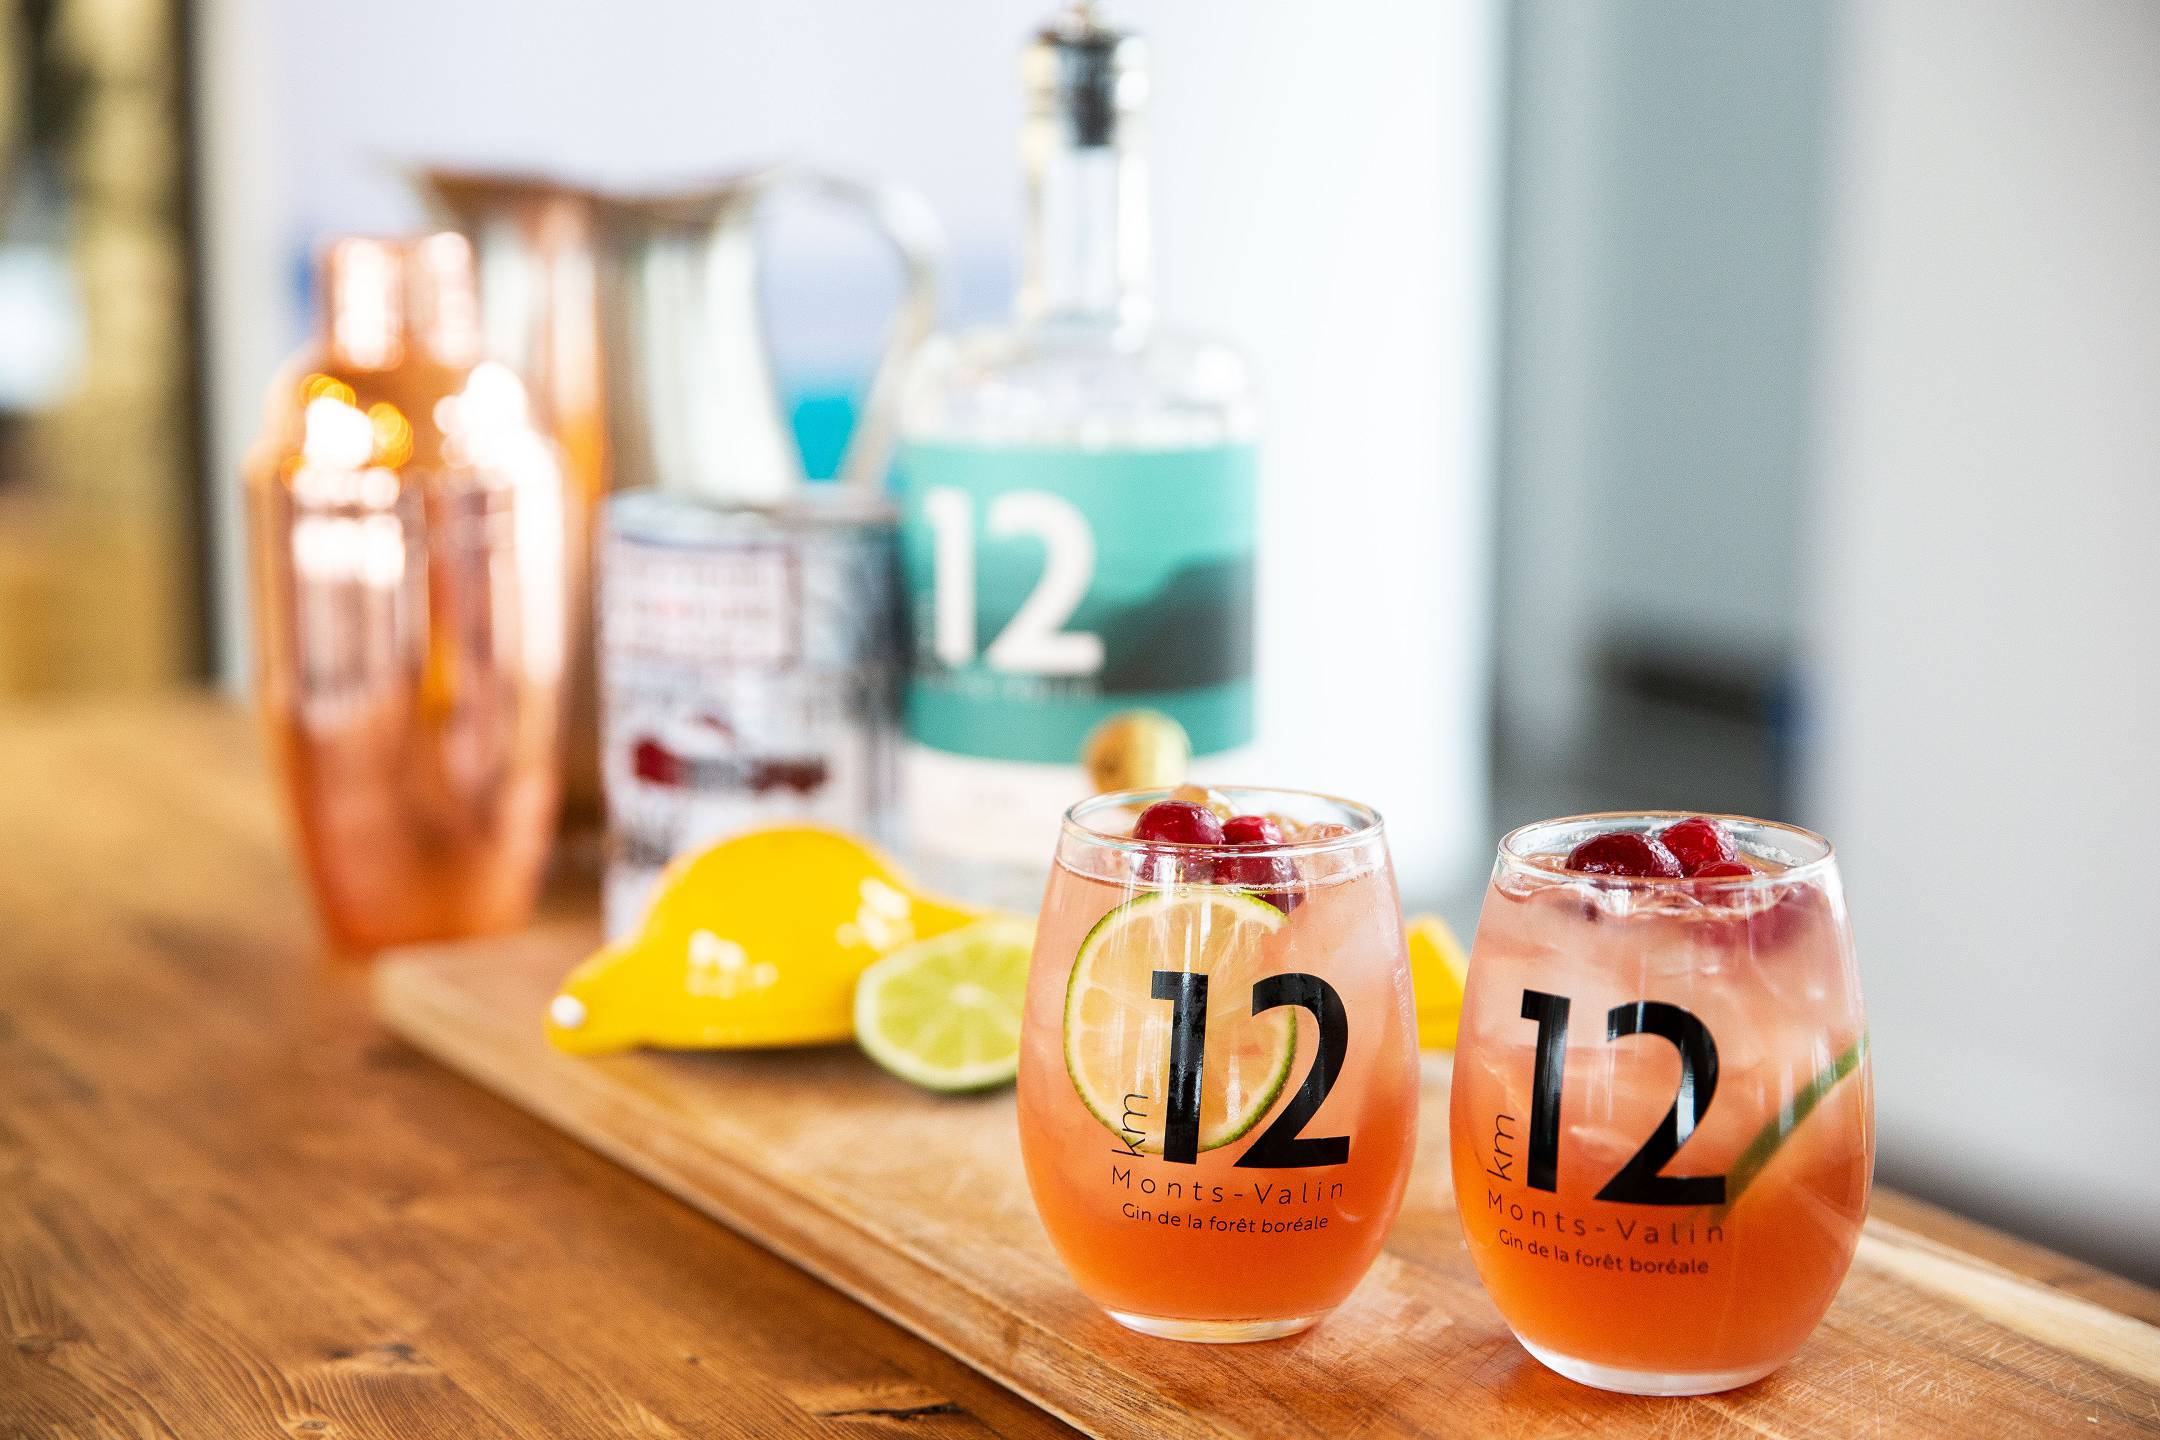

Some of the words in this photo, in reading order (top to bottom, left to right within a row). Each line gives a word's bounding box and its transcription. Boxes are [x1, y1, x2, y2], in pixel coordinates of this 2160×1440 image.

[924, 486, 1105, 676] 12
[1151, 970, 1350, 1169] 12
[1520, 988, 1727, 1207] 12
[1111, 1093, 1149, 1158] km
[1486, 1113, 1515, 1182] km
[1111, 1165, 1344, 1205] Monts-Valin
[1488, 1188, 1725, 1246] Monts-Valin
[1122, 1202, 1151, 1222] Gin
[1157, 1210, 1182, 1227] de
[1188, 1213, 1202, 1230] la
[1209, 1215, 1257, 1233] forêt
[1261, 1215, 1329, 1234] boréale
[1499, 1228, 1523, 1250] Gin
[1528, 1240, 1549, 1258] de
[1554, 1245, 1569, 1263] la
[1575, 1250, 1624, 1271] forêt
[1629, 1257, 1710, 1275] boréale
